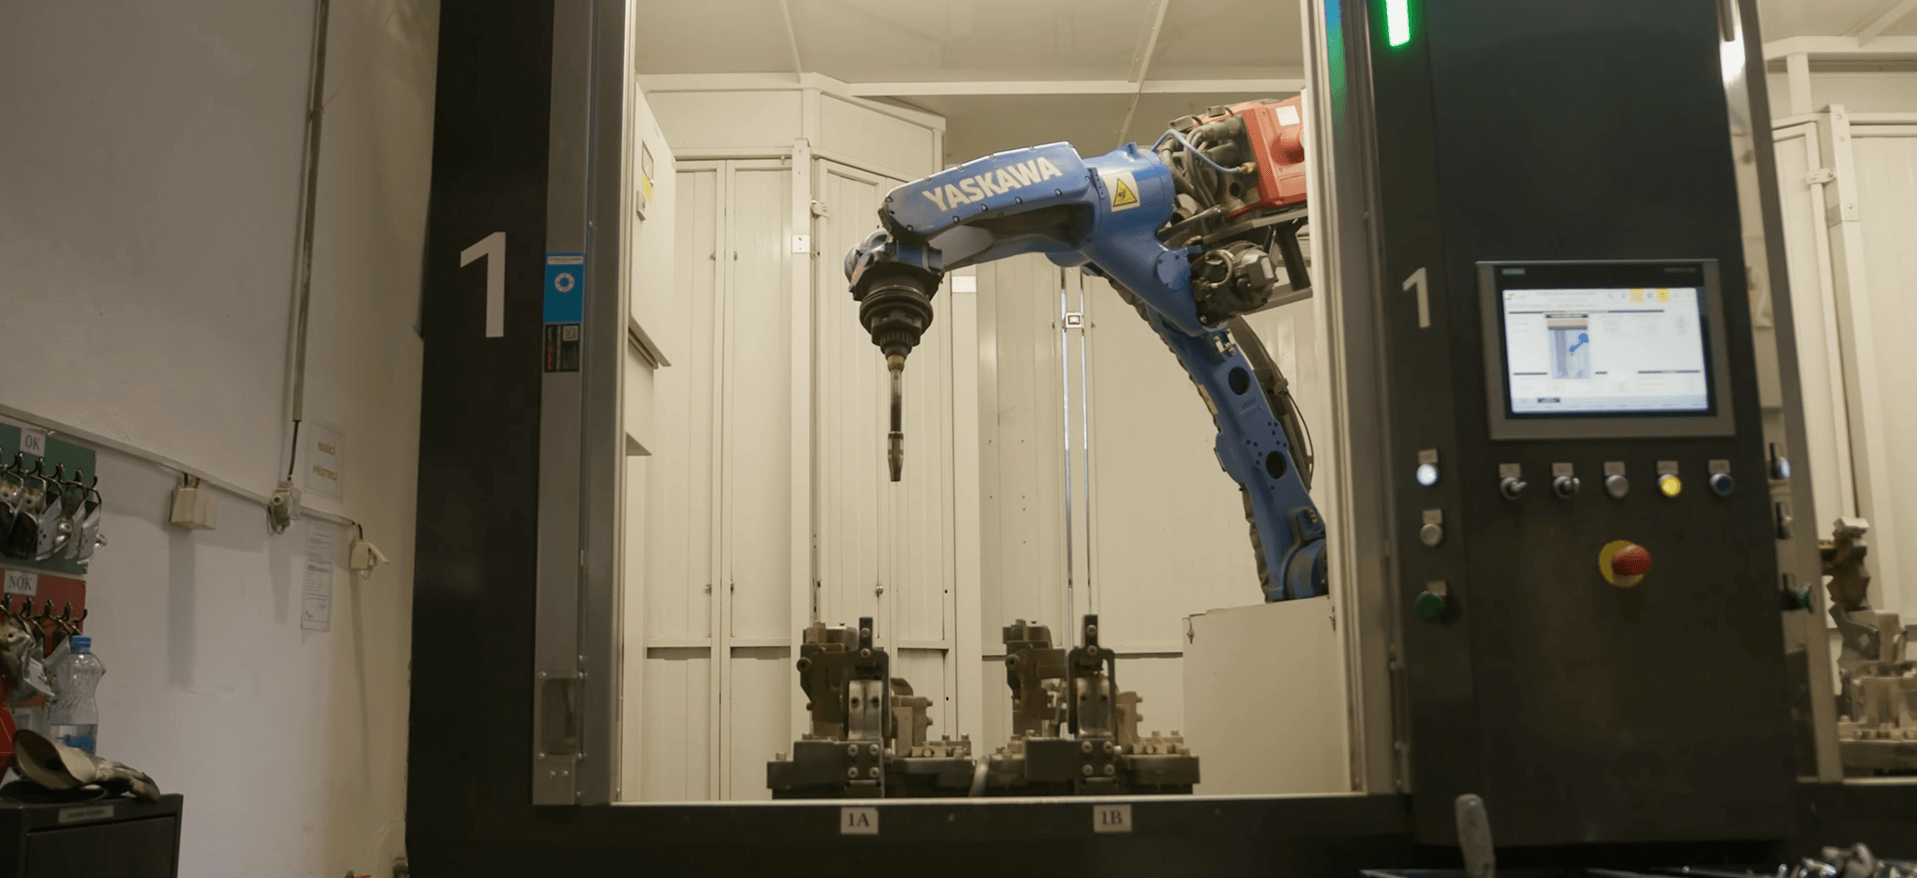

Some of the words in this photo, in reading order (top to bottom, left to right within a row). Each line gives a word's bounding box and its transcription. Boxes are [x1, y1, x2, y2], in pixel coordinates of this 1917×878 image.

[921, 156, 1063, 212] YASKAWA
[460, 231, 506, 338] 1
[1402, 266, 1430, 328] 1
[25, 434, 40, 450] OK
[9, 575, 32, 590] NOK
[848, 812, 870, 826] 1A
[1101, 810, 1123, 825] 1B
